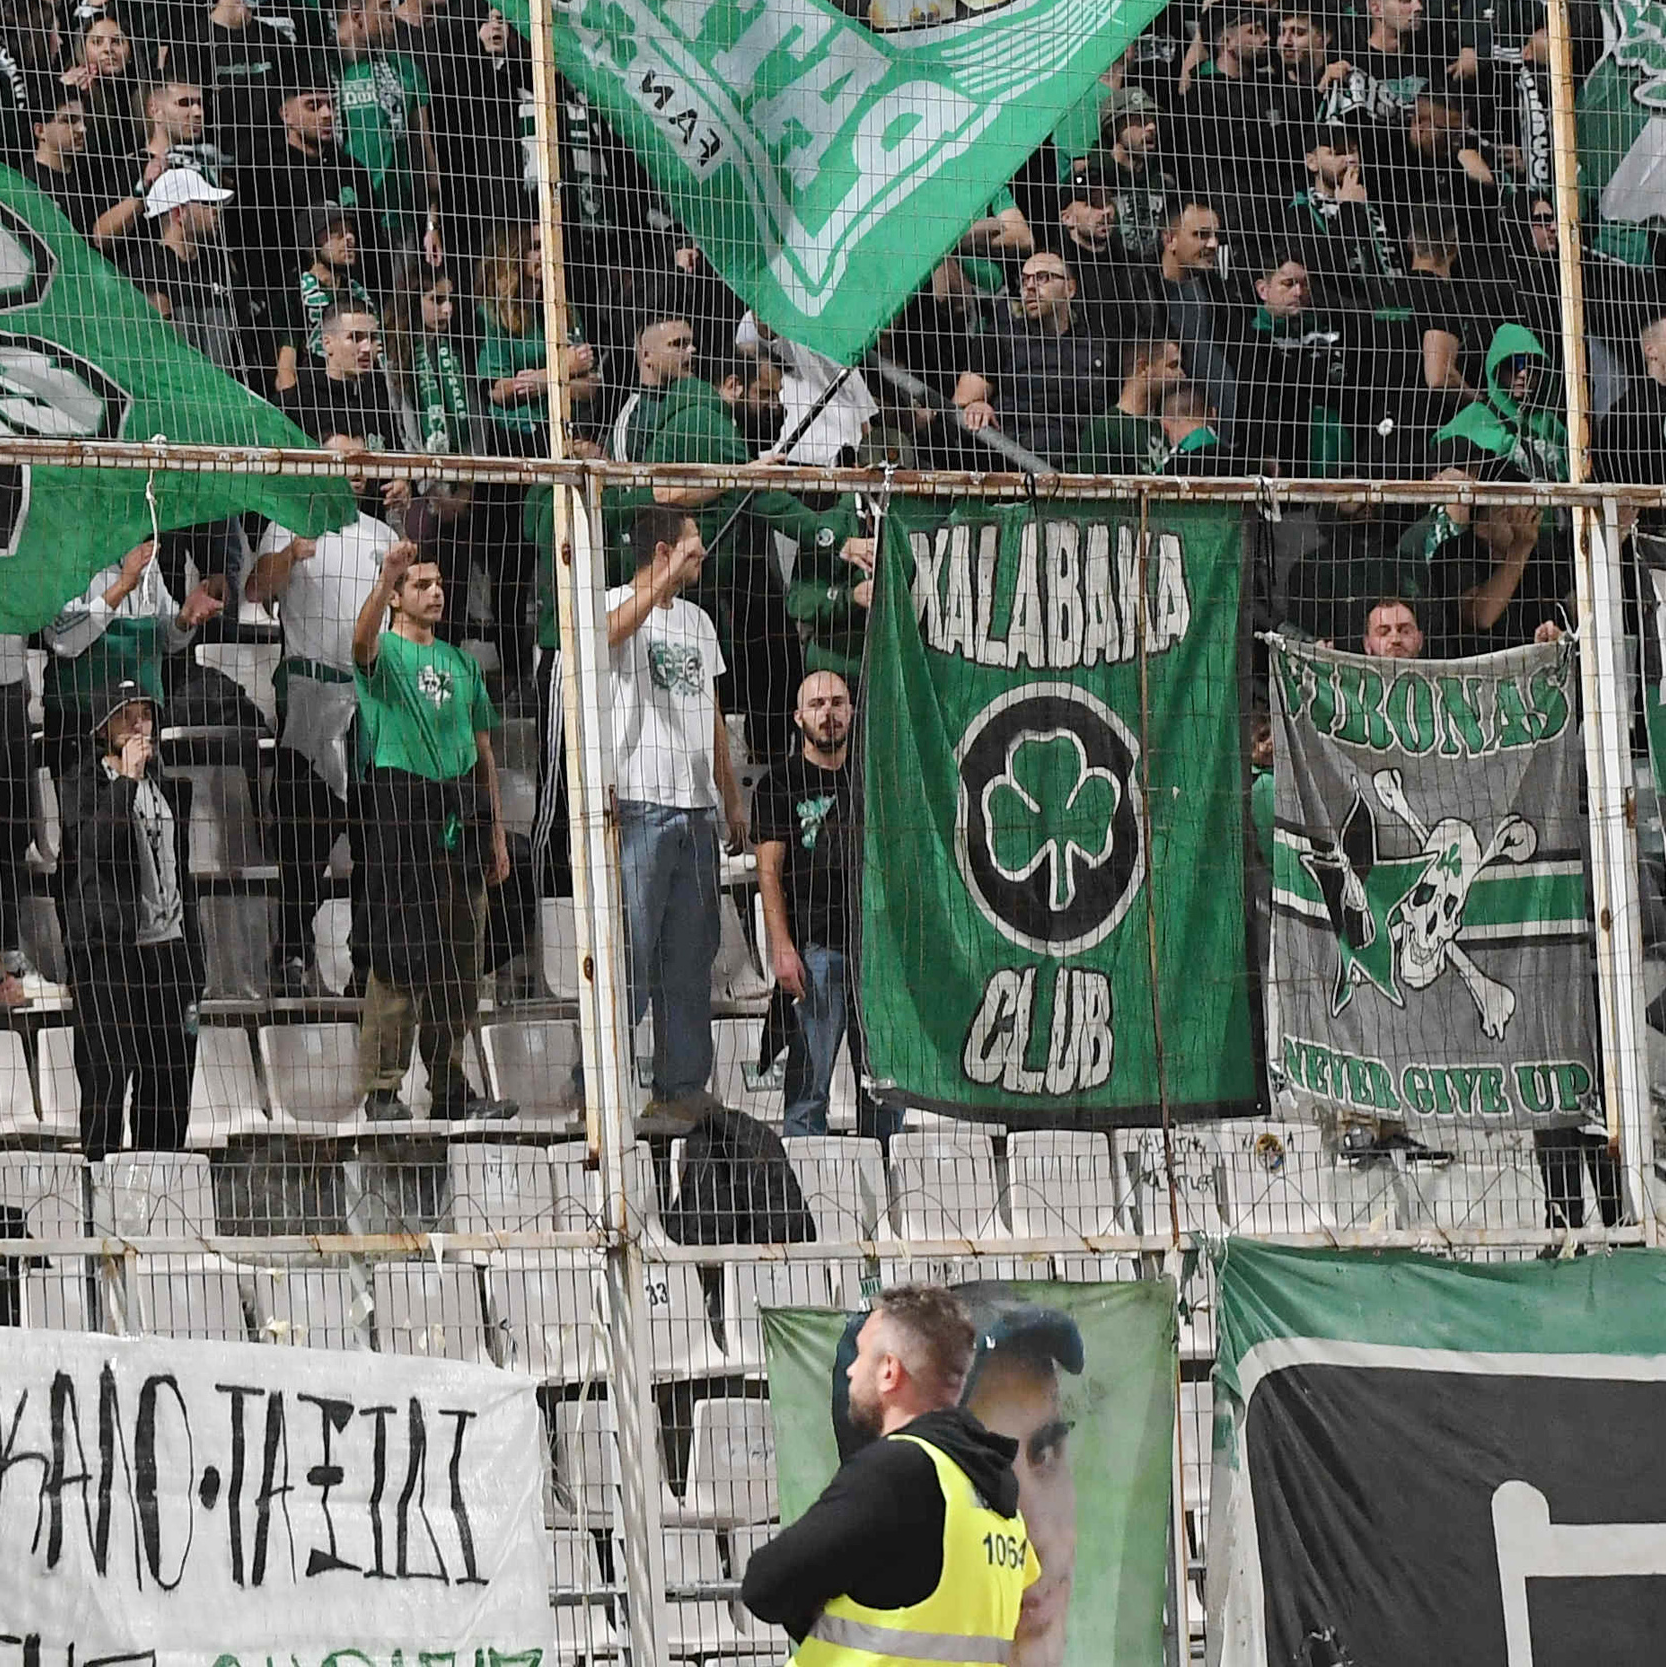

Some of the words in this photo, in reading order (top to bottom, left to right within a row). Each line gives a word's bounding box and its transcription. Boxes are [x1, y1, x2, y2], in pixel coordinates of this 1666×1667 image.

[962, 966, 1114, 1095] CLUB
[1282, 1035, 1401, 1115] NEVER
[1401, 1061, 1510, 1118] GIVE
[1513, 1059, 1594, 1116] UP
